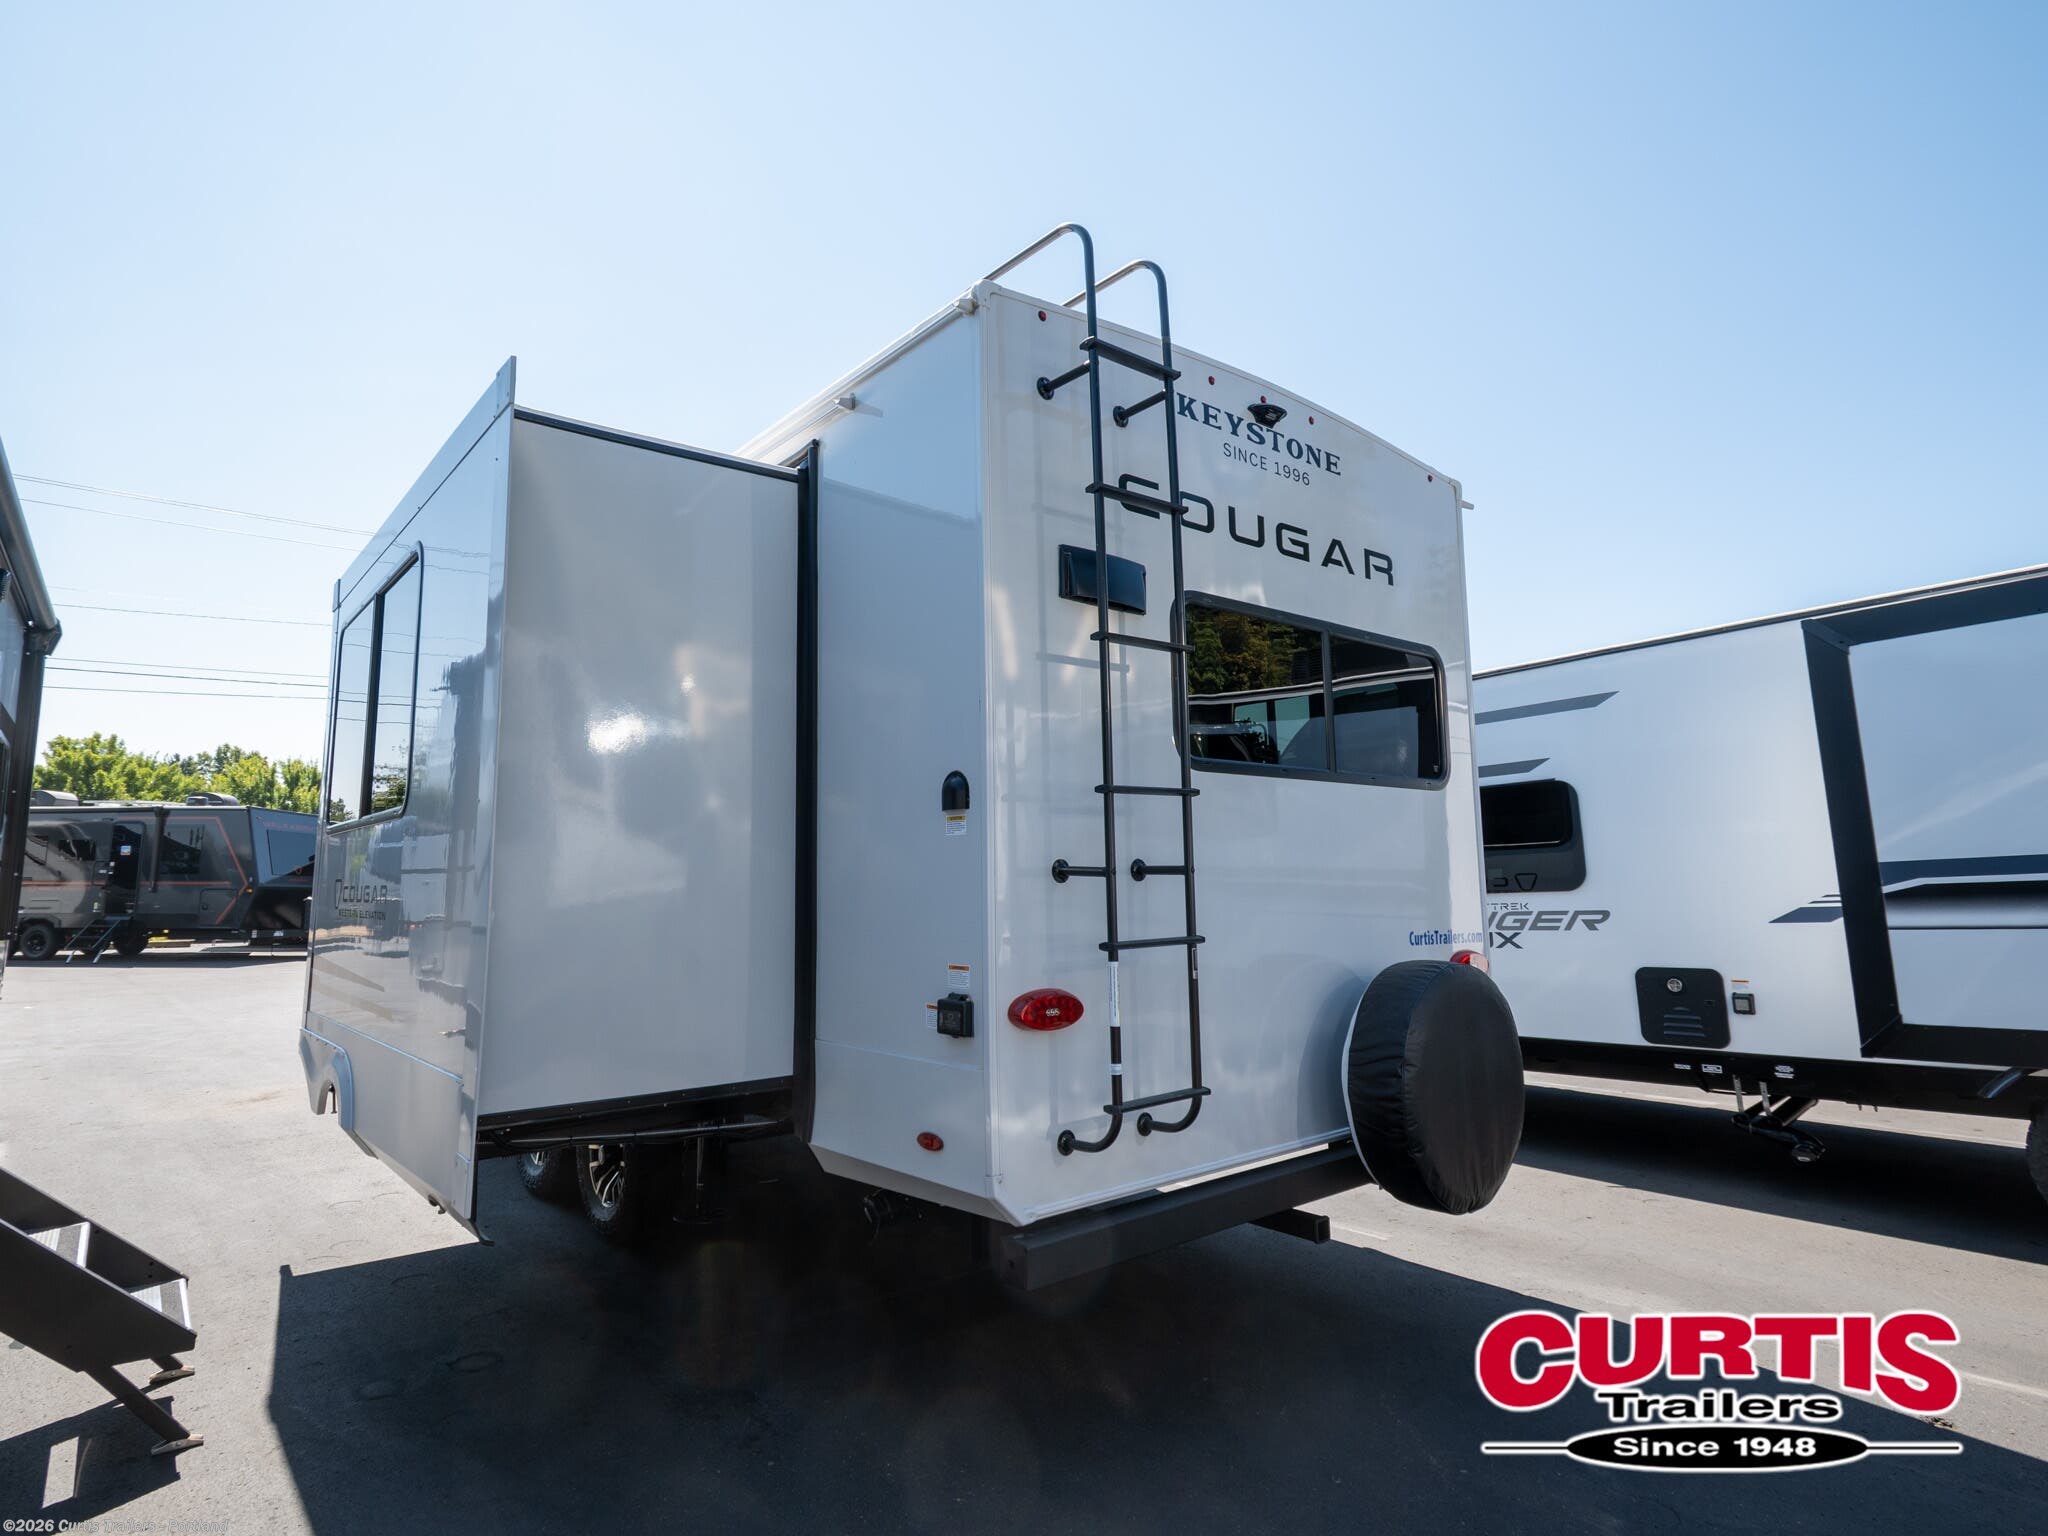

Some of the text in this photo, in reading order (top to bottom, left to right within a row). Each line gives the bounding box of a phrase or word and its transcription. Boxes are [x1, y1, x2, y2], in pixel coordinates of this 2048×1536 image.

[1176, 392, 1342, 476] KEYSTONE
[1223, 442, 1311, 486] SINCE 1996
[1118, 473, 1395, 586] COUGAR
[342, 884, 388, 904] COUGAR
[1487, 902, 1530, 911] TREK
[1409, 928, 1483, 947] CurtisTrailers.com
